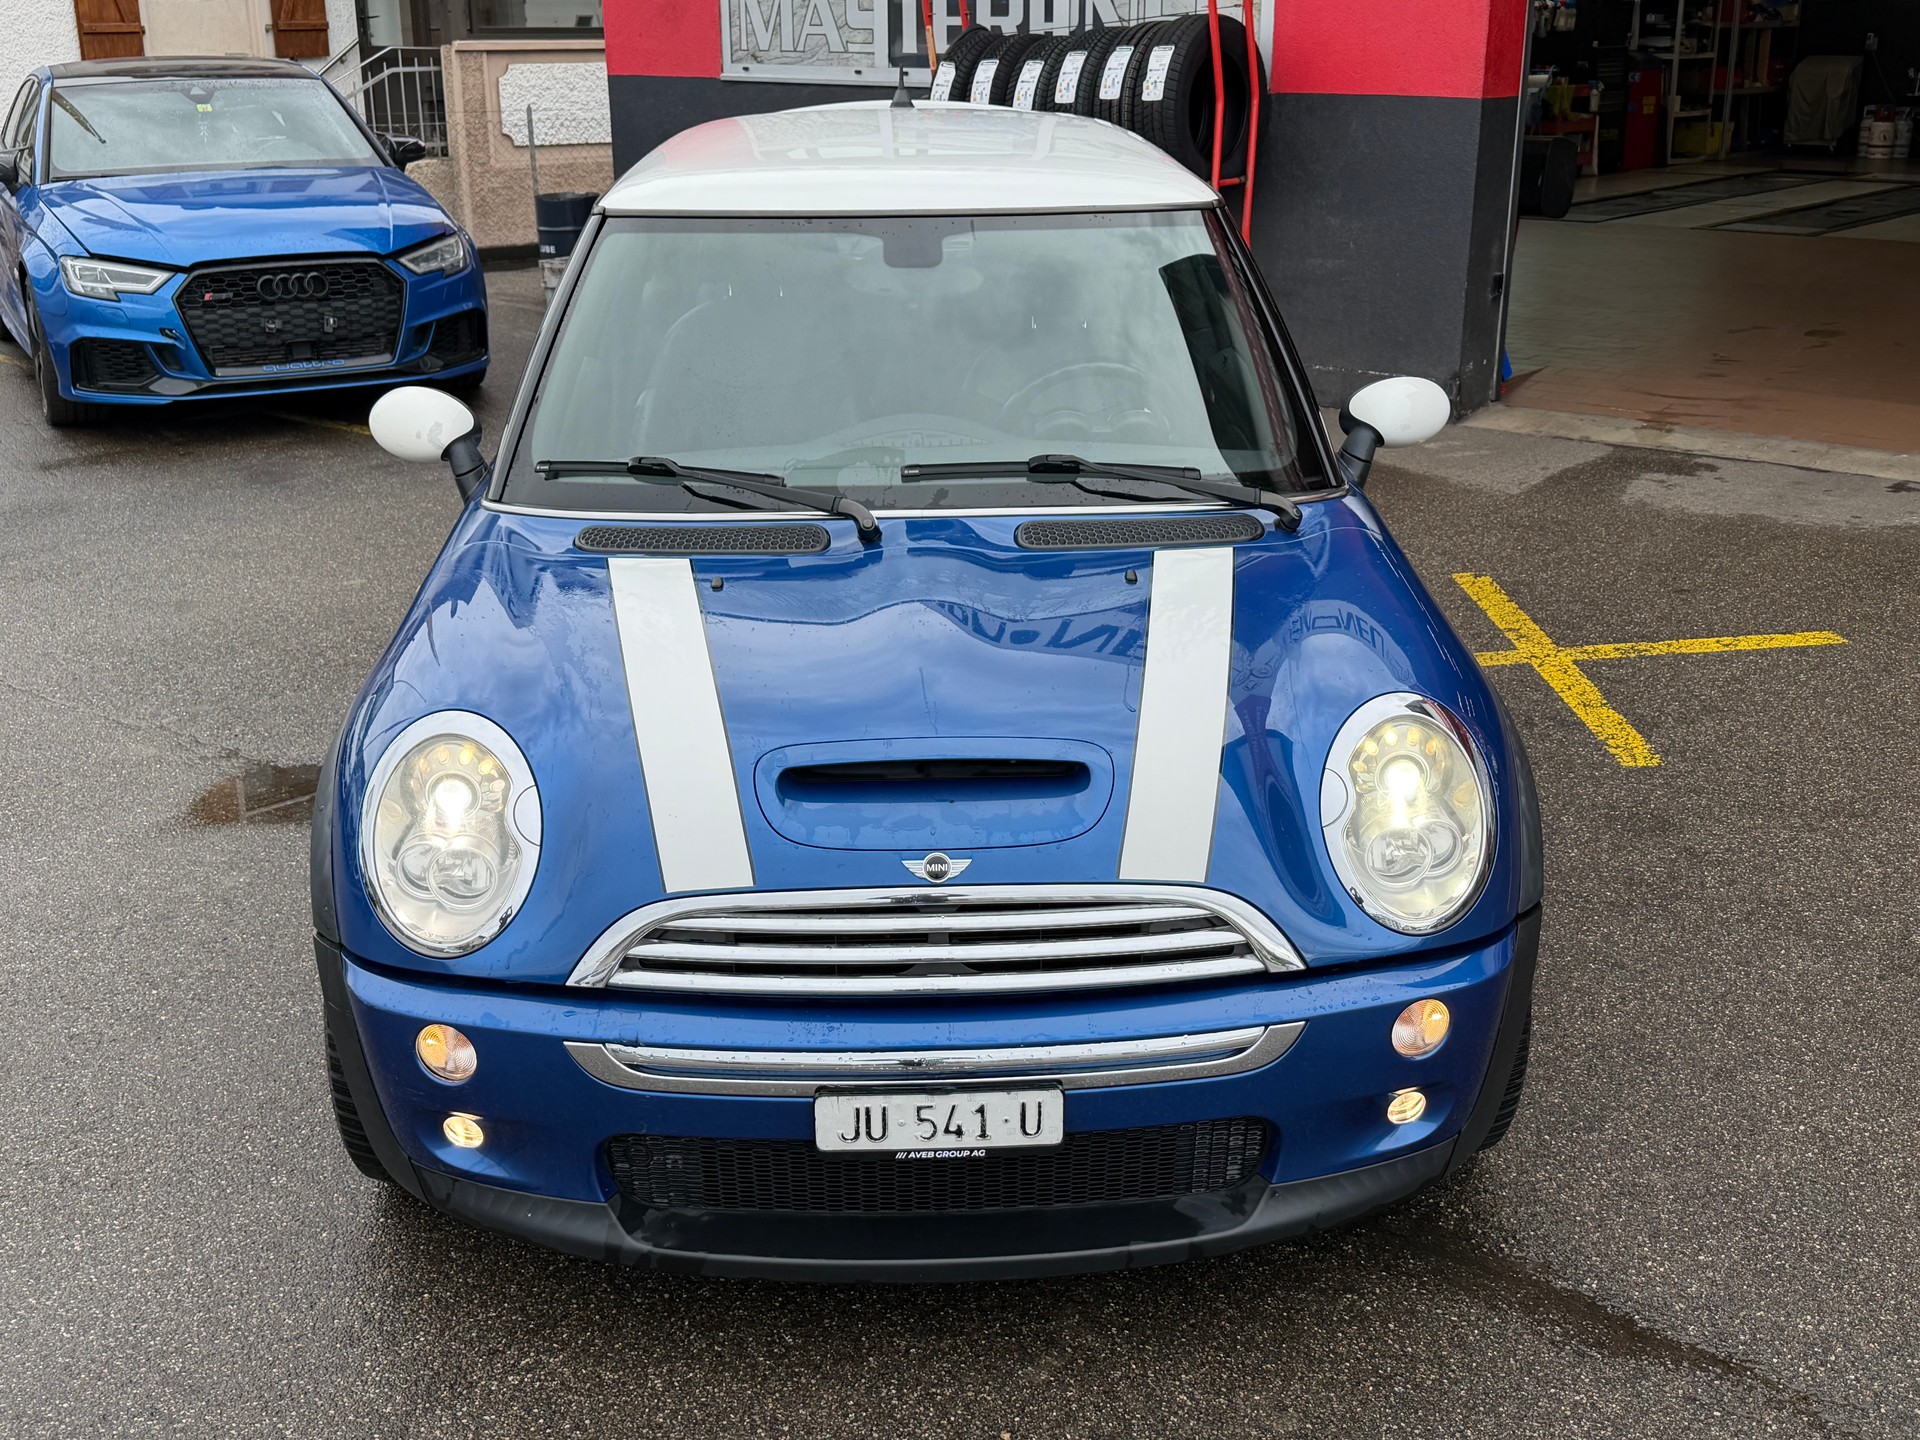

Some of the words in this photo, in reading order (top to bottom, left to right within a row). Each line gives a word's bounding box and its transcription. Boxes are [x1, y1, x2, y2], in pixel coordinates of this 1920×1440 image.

[263, 360, 345, 372] quattro
[926, 863, 949, 872] MINI
[838, 1104, 889, 1143] JU
[914, 1103, 991, 1142] 541
[1019, 1099, 1044, 1139] U
[908, 1151, 934, 1159] AVEB
[935, 1150, 970, 1158] GROUP
[971, 1149, 986, 1157] AG
